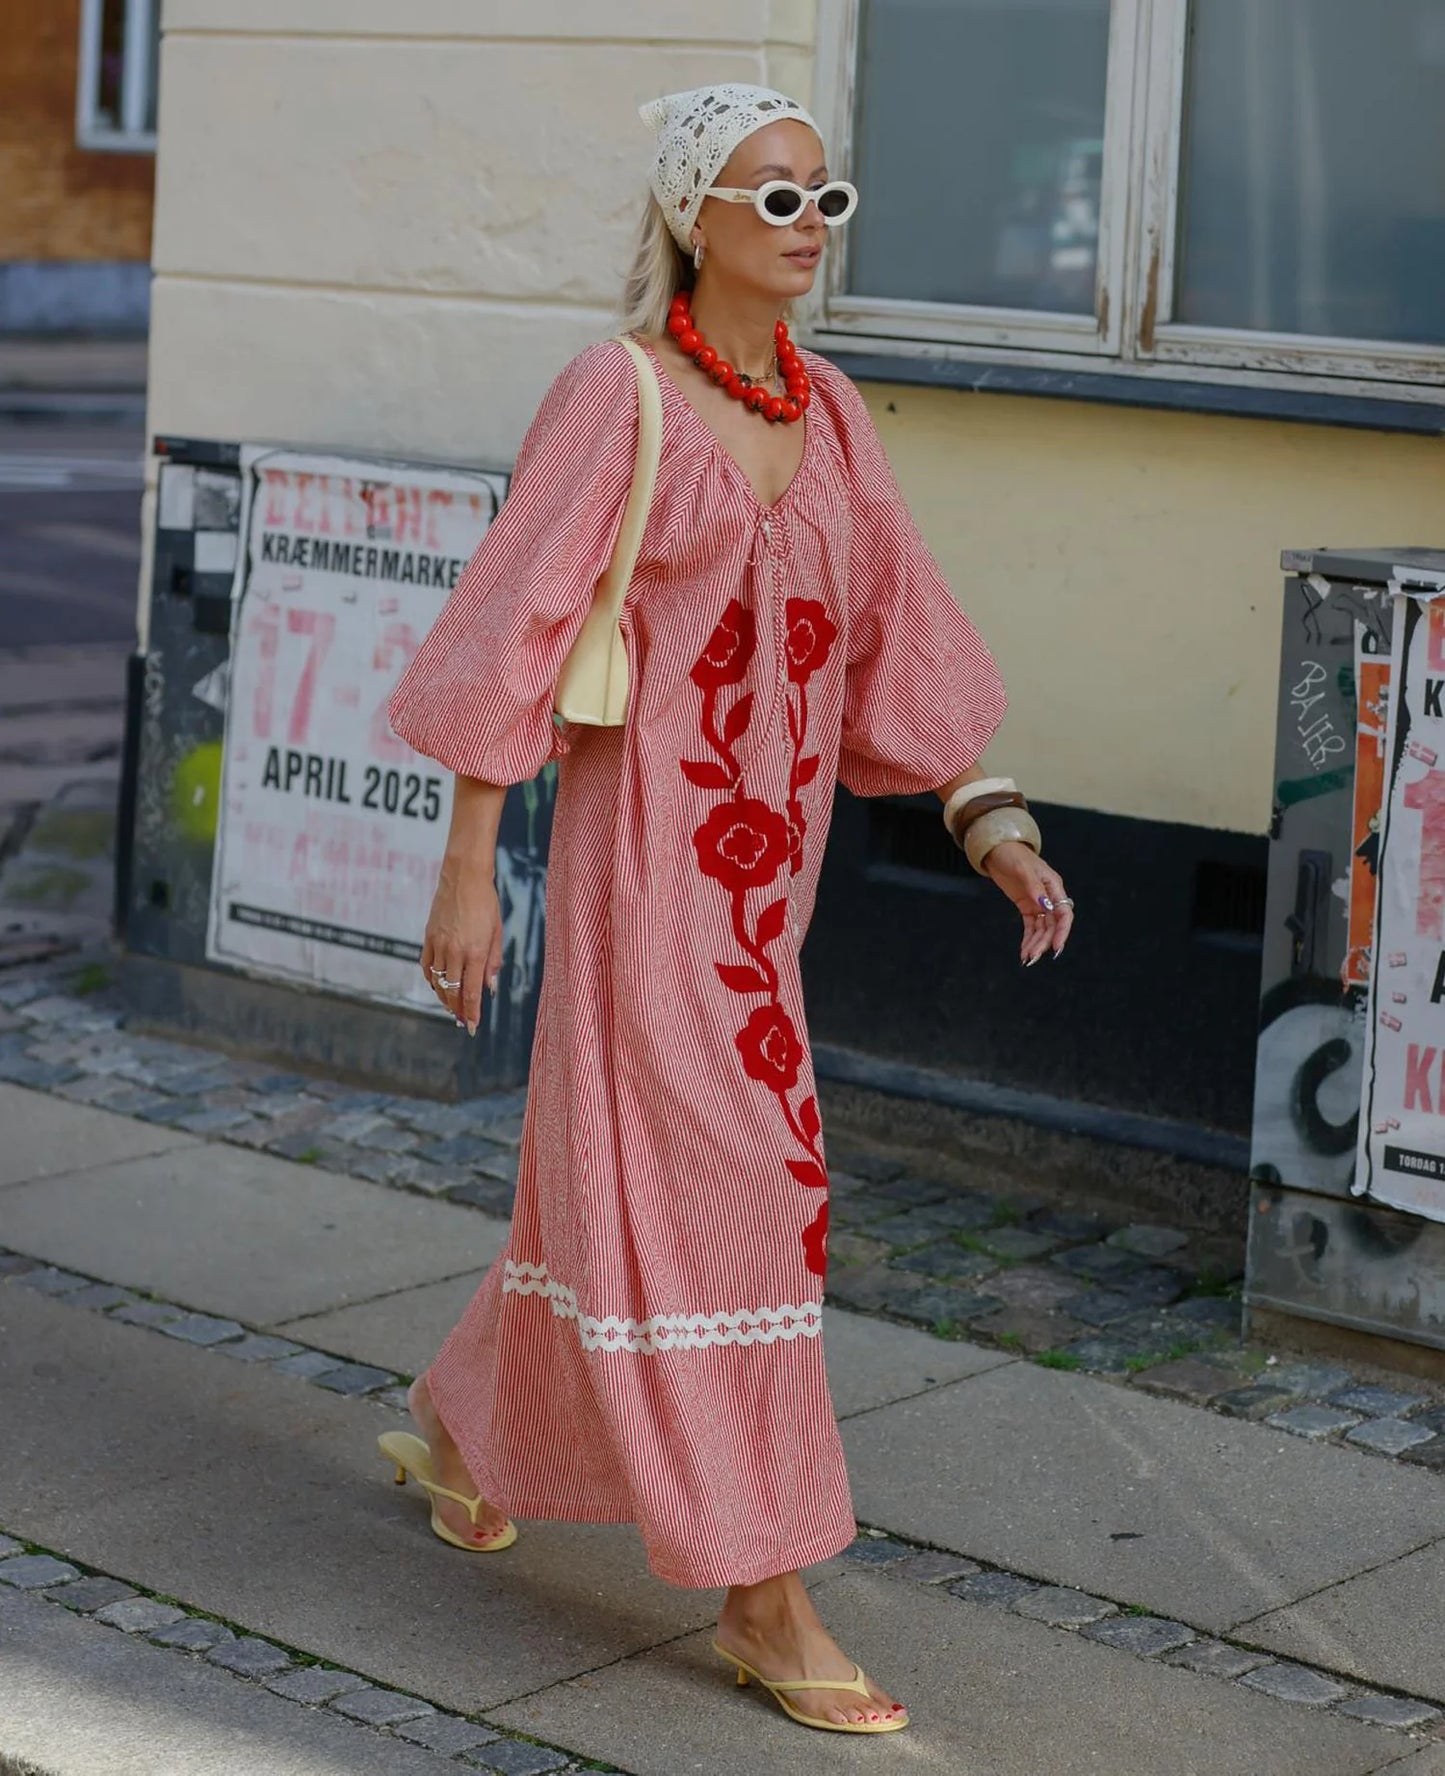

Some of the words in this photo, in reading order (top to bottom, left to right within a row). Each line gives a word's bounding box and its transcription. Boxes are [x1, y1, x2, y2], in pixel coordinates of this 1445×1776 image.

[262, 531, 469, 590] KRÆMMERMARKE
[261, 746, 351, 804] APRIL
[362, 766, 442, 822] 2025
[1399, 1153, 1437, 1173] TORDAG
